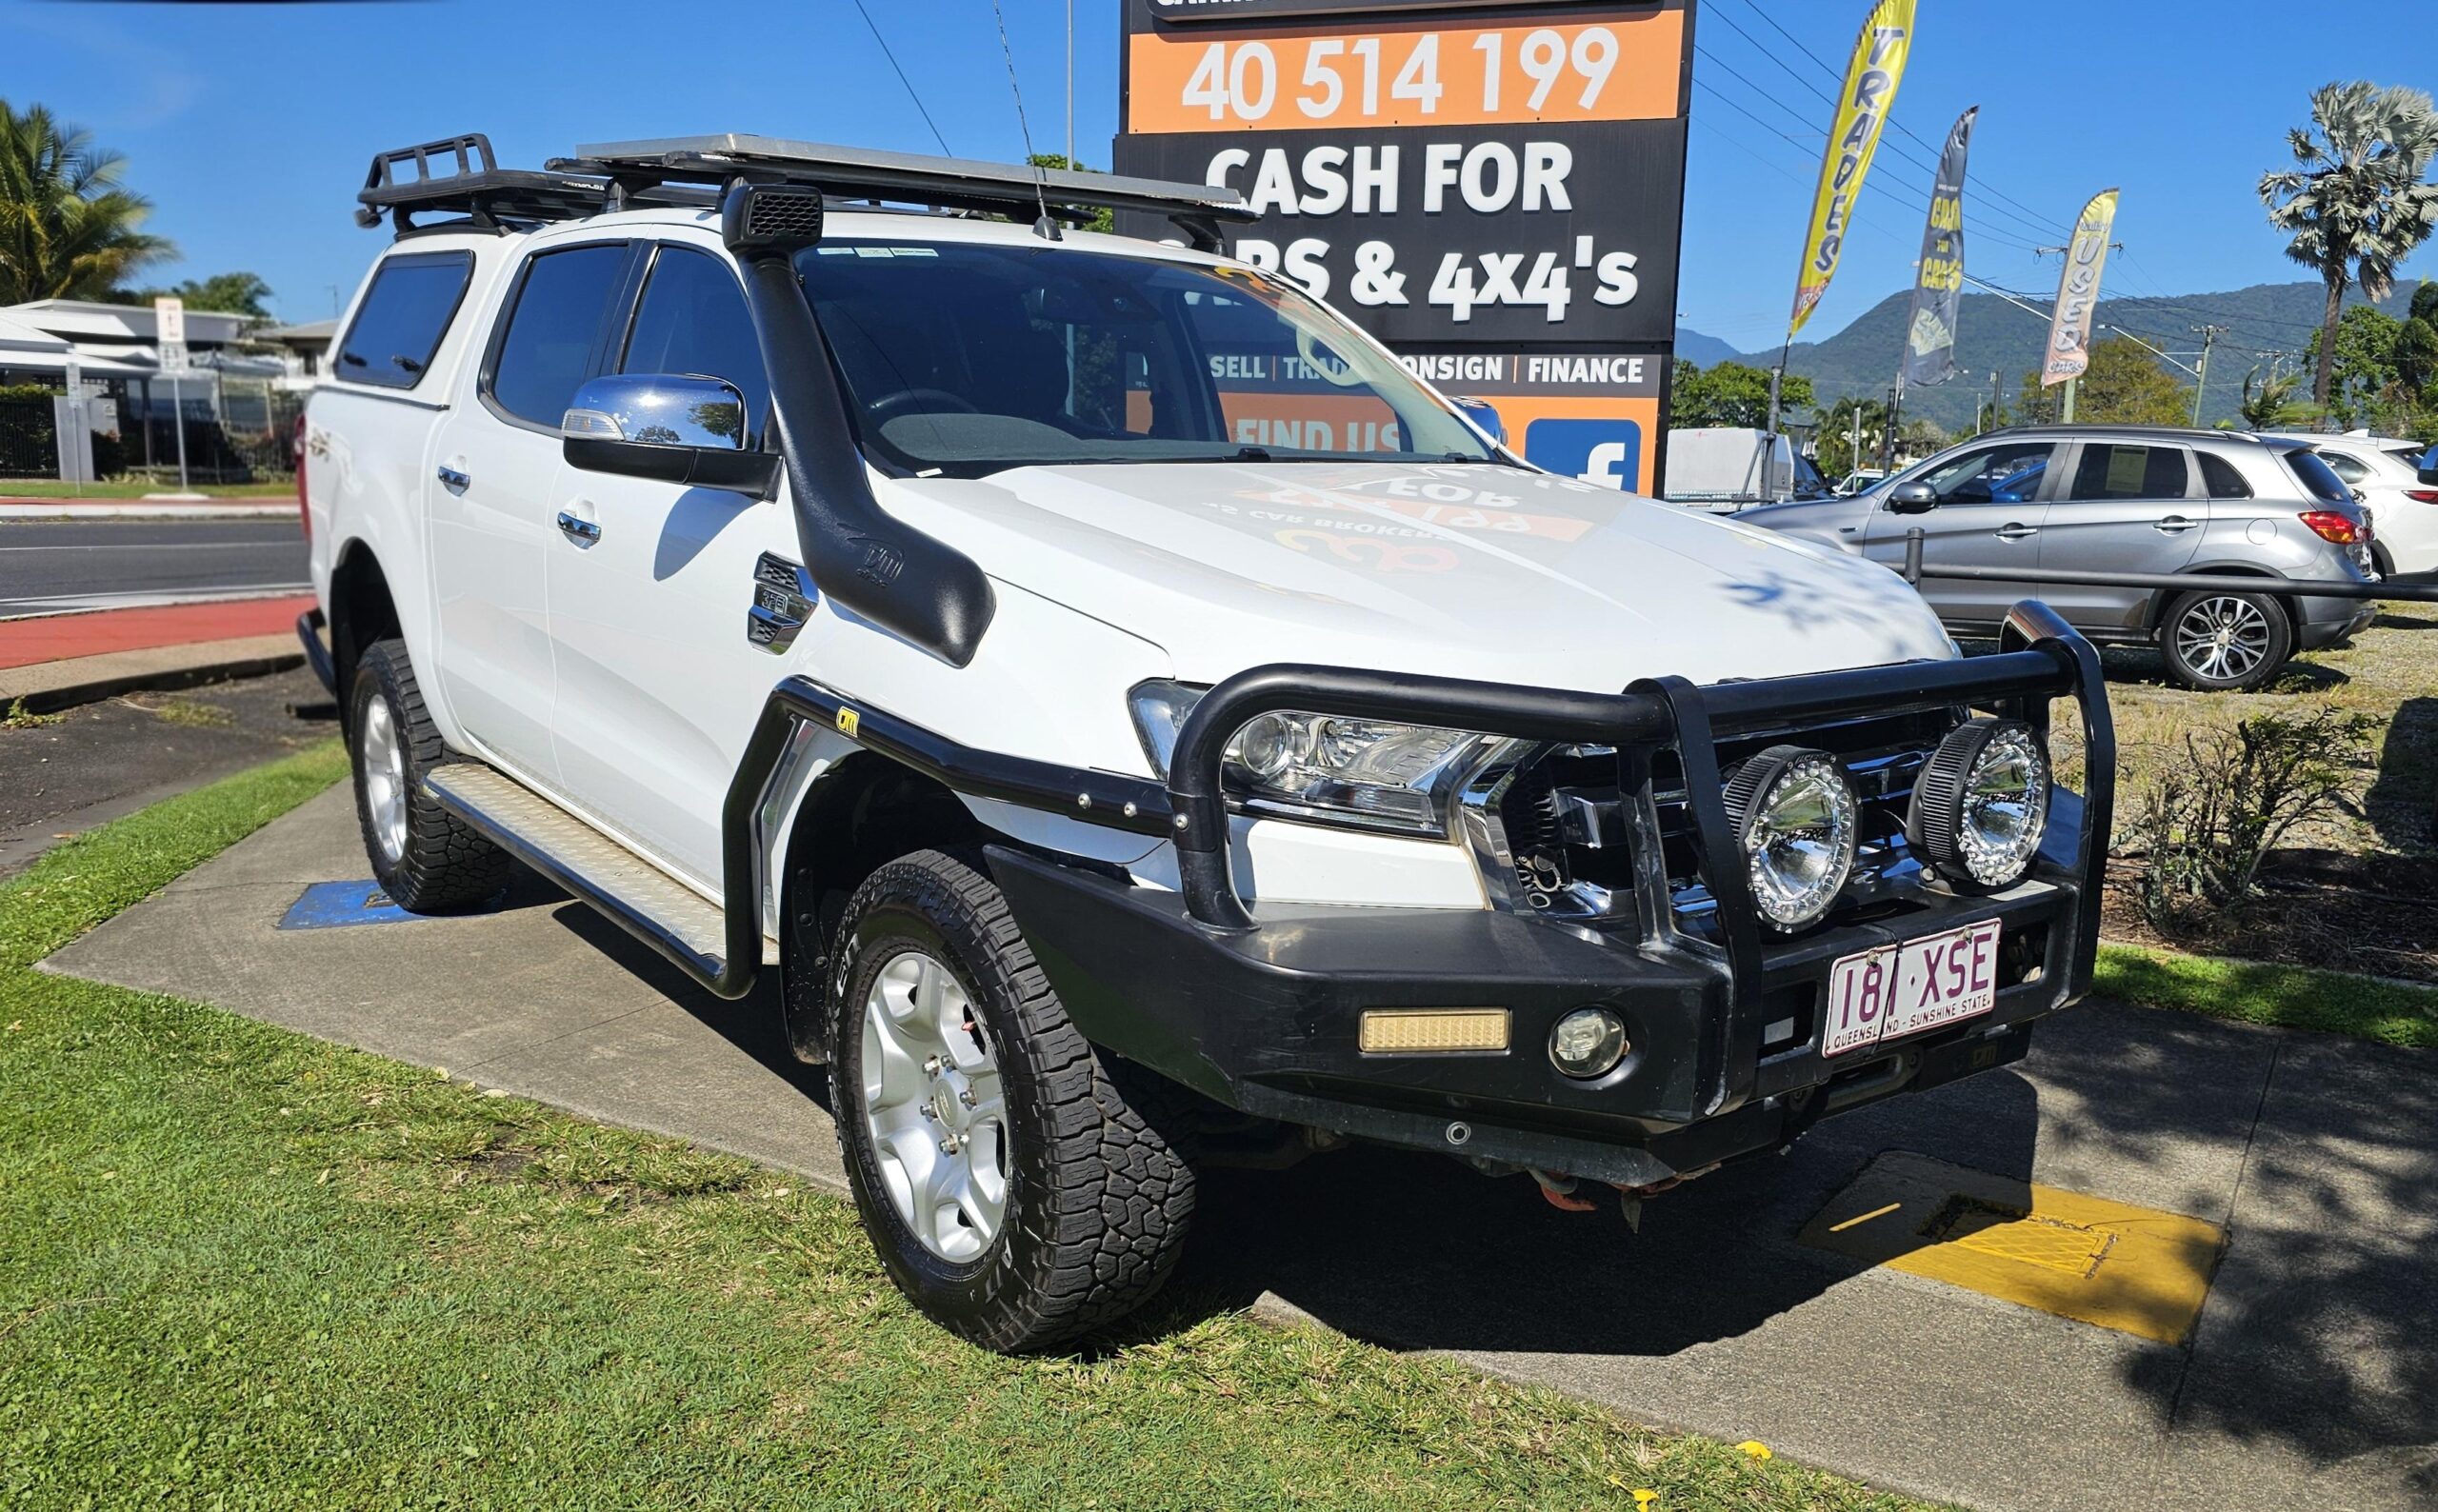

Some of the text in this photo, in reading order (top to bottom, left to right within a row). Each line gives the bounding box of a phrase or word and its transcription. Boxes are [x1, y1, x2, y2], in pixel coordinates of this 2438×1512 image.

[1182, 27, 1619, 120] 40 514 199
[1206, 142, 1573, 215] CASH FOR
[1814, 27, 1904, 273] TRADES
[1350, 240, 1409, 306] &
[2054, 235, 2104, 352] USED
[1211, 356, 1266, 379] SELL
[1400, 355, 1502, 380] ONSIGN
[1528, 358, 1644, 383] FINANCE
[2048, 359, 2086, 374] CARS
[1917, 932, 1992, 1008] XSE
[1909, 1003, 1957, 1027] SUNSHINE
